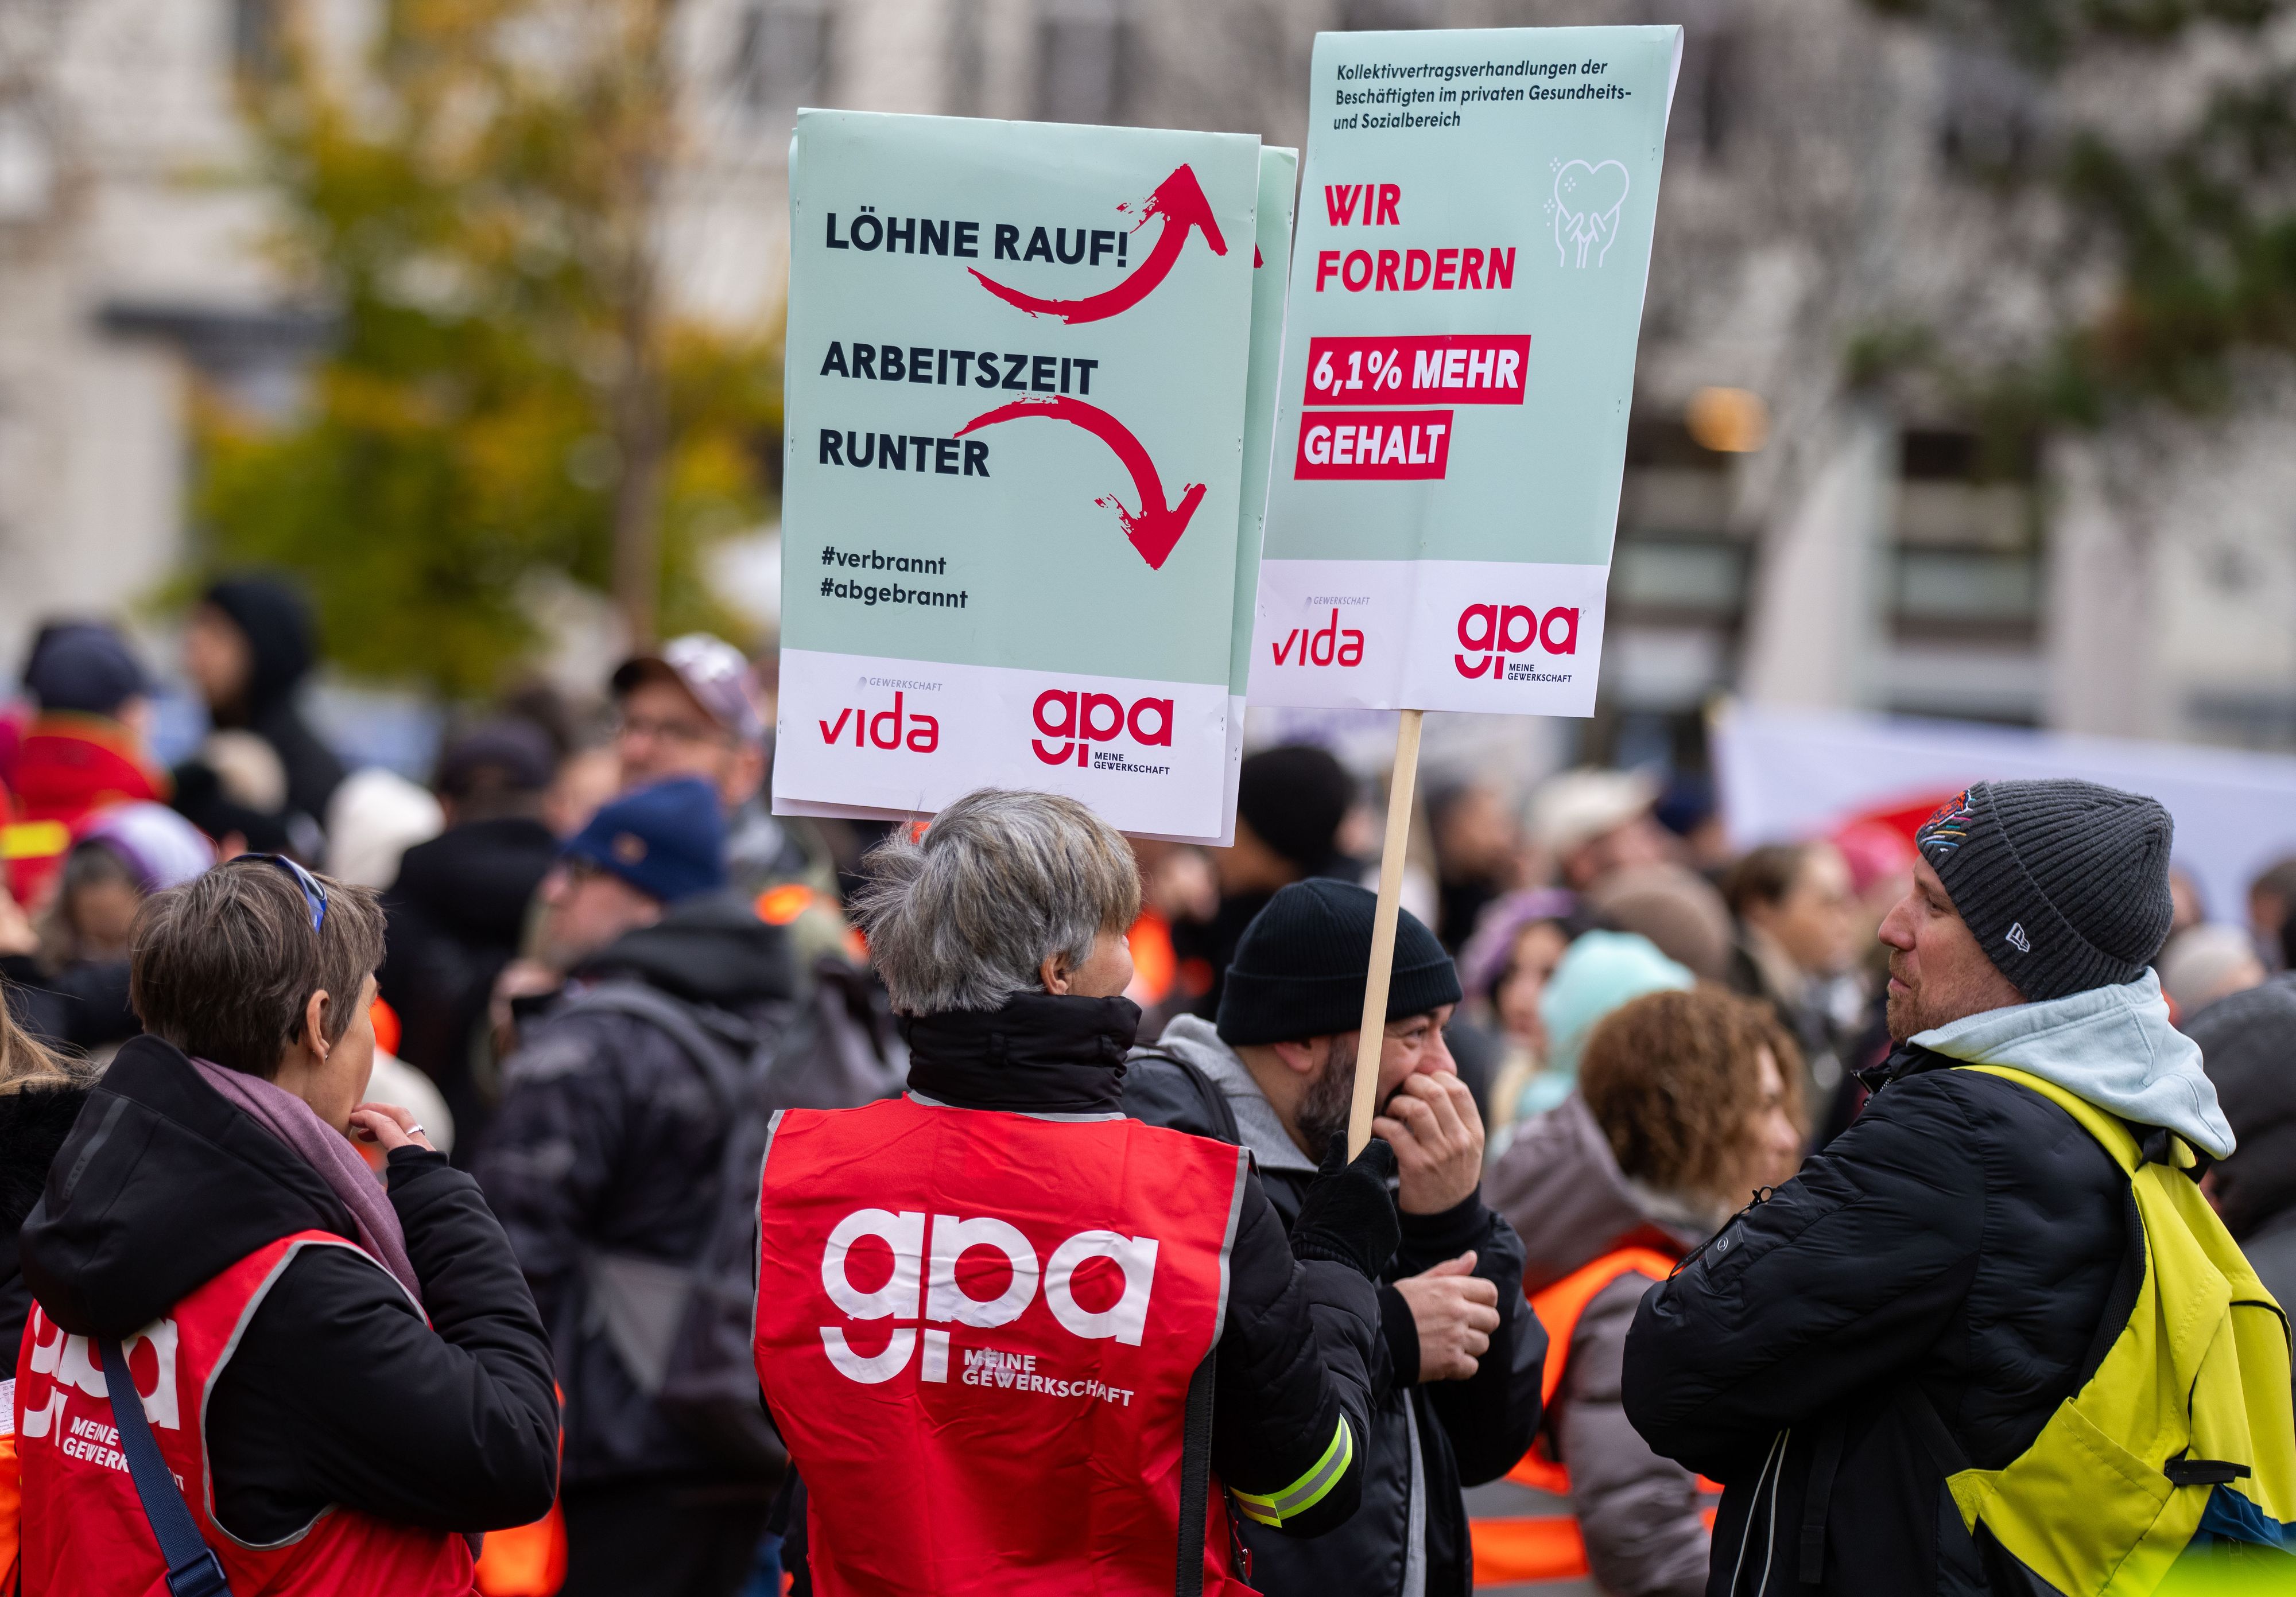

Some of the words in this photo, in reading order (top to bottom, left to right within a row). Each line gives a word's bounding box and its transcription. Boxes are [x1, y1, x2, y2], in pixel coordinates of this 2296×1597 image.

[1338, 61, 1576, 81] Kollektivvertragsverhandlungen
[1581, 59, 1608, 74] der
[1337, 88, 1434, 107] Beschäftigten
[1440, 87, 1456, 102] im
[1461, 87, 1523, 105] privaten
[1529, 84, 1631, 100] Gesundheits-
[1334, 114, 1358, 129] und
[1362, 111, 1460, 128] Sozialbereich
[1325, 184, 1400, 226] WIR
[827, 206, 979, 258] LÖHNE
[995, 224, 1127, 267] RAUF!
[1316, 248, 1515, 292] FORDERN
[820, 341, 1098, 395] ARBEITSZEIT
[1313, 349, 1402, 396] 6,1%
[1413, 349, 1519, 388] MEHR
[820, 429, 990, 477] RUNTER
[1304, 425, 1445, 464] GEHALT
[822, 546, 946, 574] #verbrannt
[821, 578, 968, 608] #abgebrannt
[1313, 597, 1370, 605] GEWERKSCHAFT
[1273, 608, 1364, 667] vida
[1455, 604, 1579, 679] gpa
[870, 678, 943, 691] GEWERKSCHAFT
[1508, 673, 1572, 682] GEWERKSCHAFT
[1509, 664, 1534, 672] MEINE
[820, 691, 938, 753] vida
[1032, 689, 1173, 767] gpa
[1094, 762, 1170, 775] GEWERKSCHAFT
[1095, 752, 1124, 761] MEINE
[820, 1209, 1159, 1384] gpa
[964, 1350, 1036, 1371] MEINE
[963, 1370, 1134, 1406] GEWERKSCHAFT
[70, 1416, 119, 1446] MEINE
